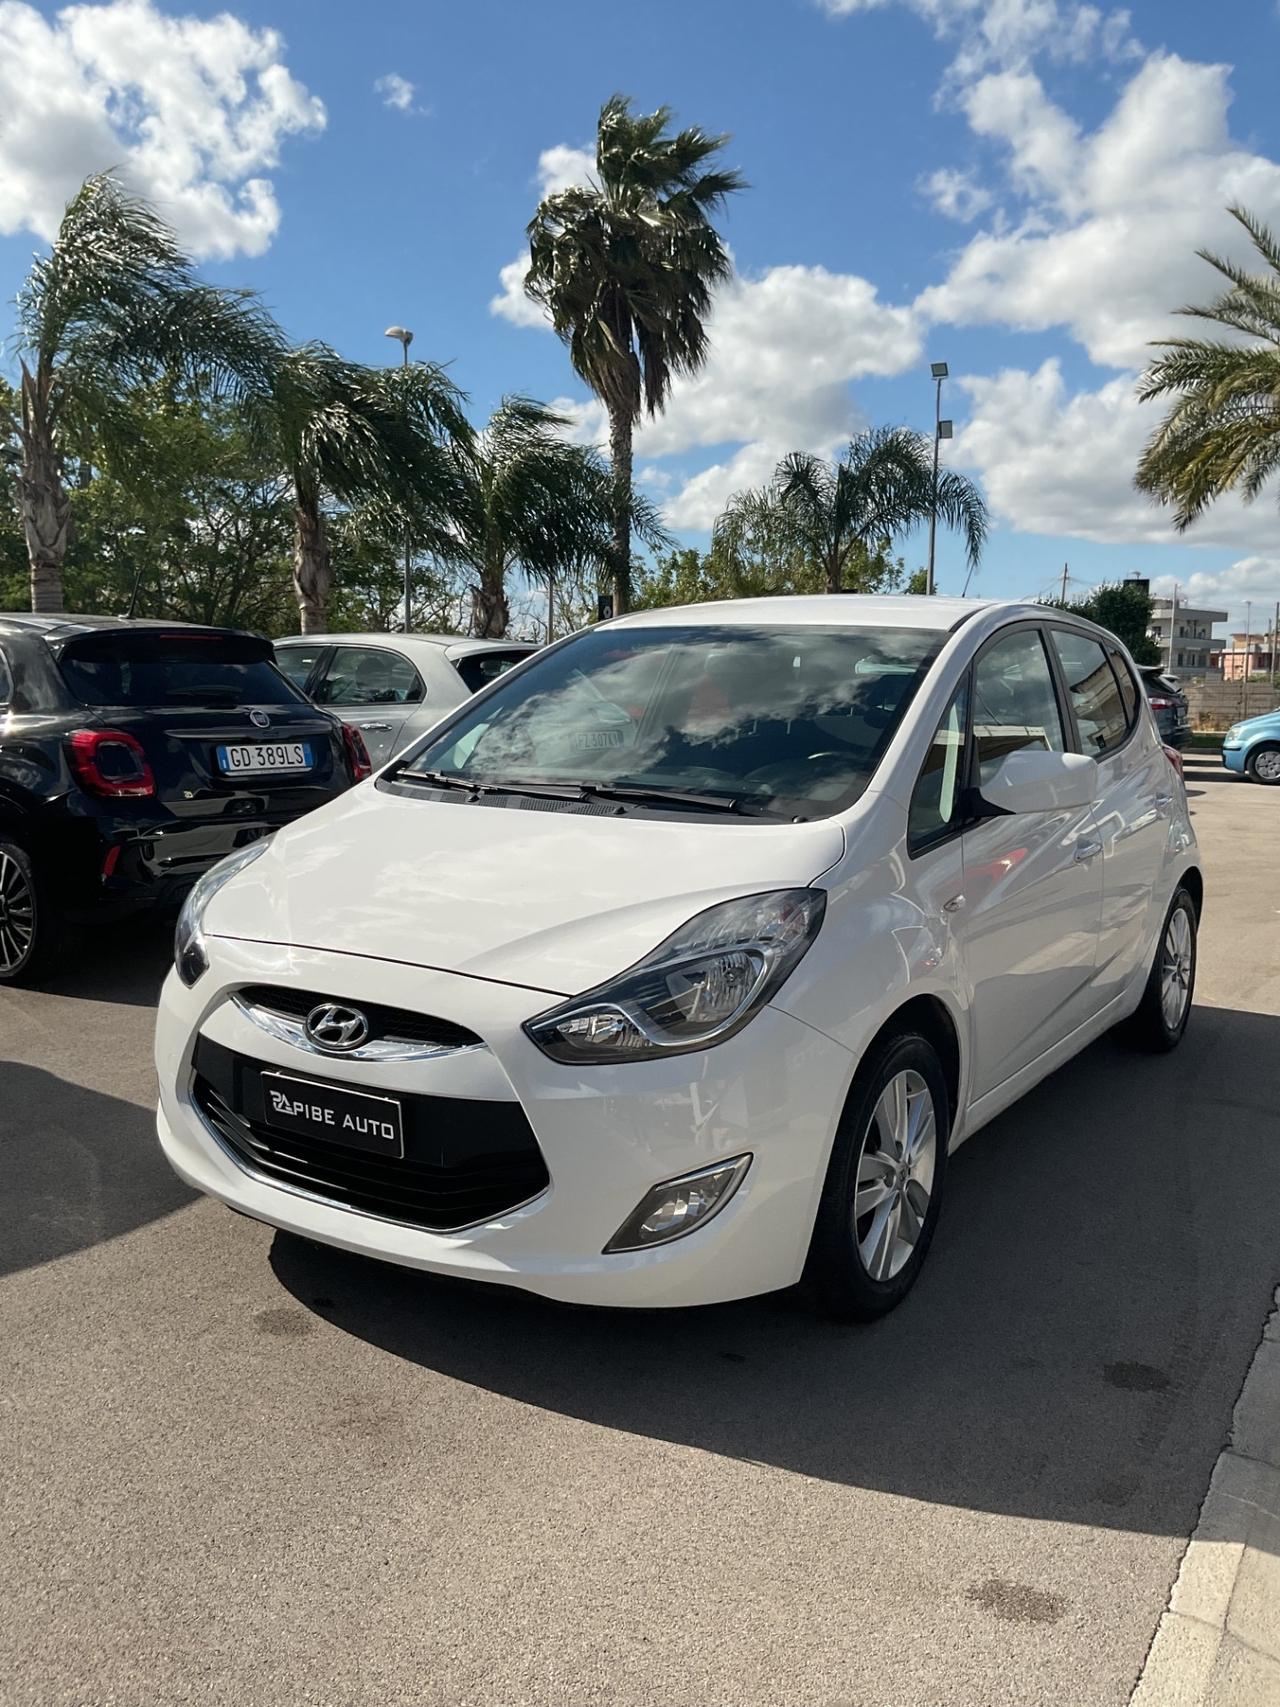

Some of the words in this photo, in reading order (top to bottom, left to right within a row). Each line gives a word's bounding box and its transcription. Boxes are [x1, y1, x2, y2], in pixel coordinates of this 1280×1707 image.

[230, 747, 251, 767] GD
[255, 746, 304, 766] 389LS
[342, 1113, 394, 1140] AUTO
